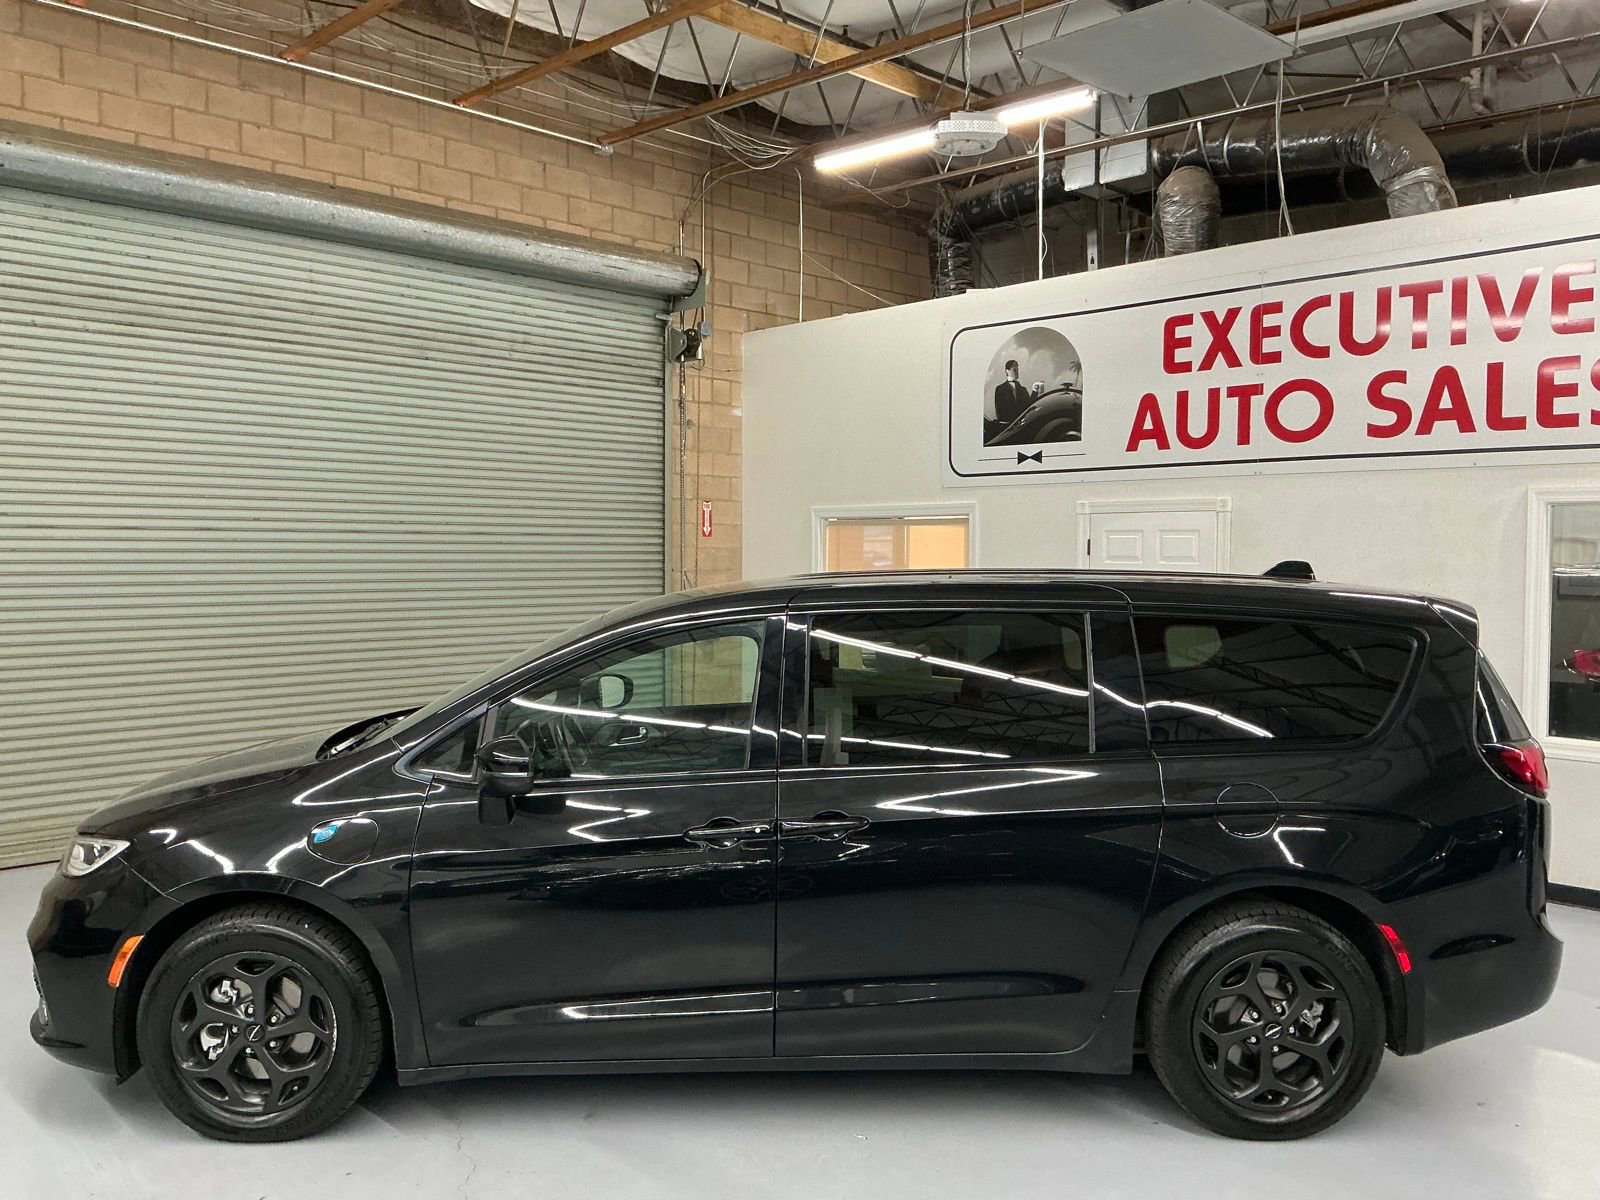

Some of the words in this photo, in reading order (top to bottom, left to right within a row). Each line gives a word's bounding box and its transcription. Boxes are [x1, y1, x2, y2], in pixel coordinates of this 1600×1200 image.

[1162, 259, 1597, 375] EXECUTIVE
[1125, 378, 1335, 453] AUTO
[1366, 354, 1600, 439] SALE
